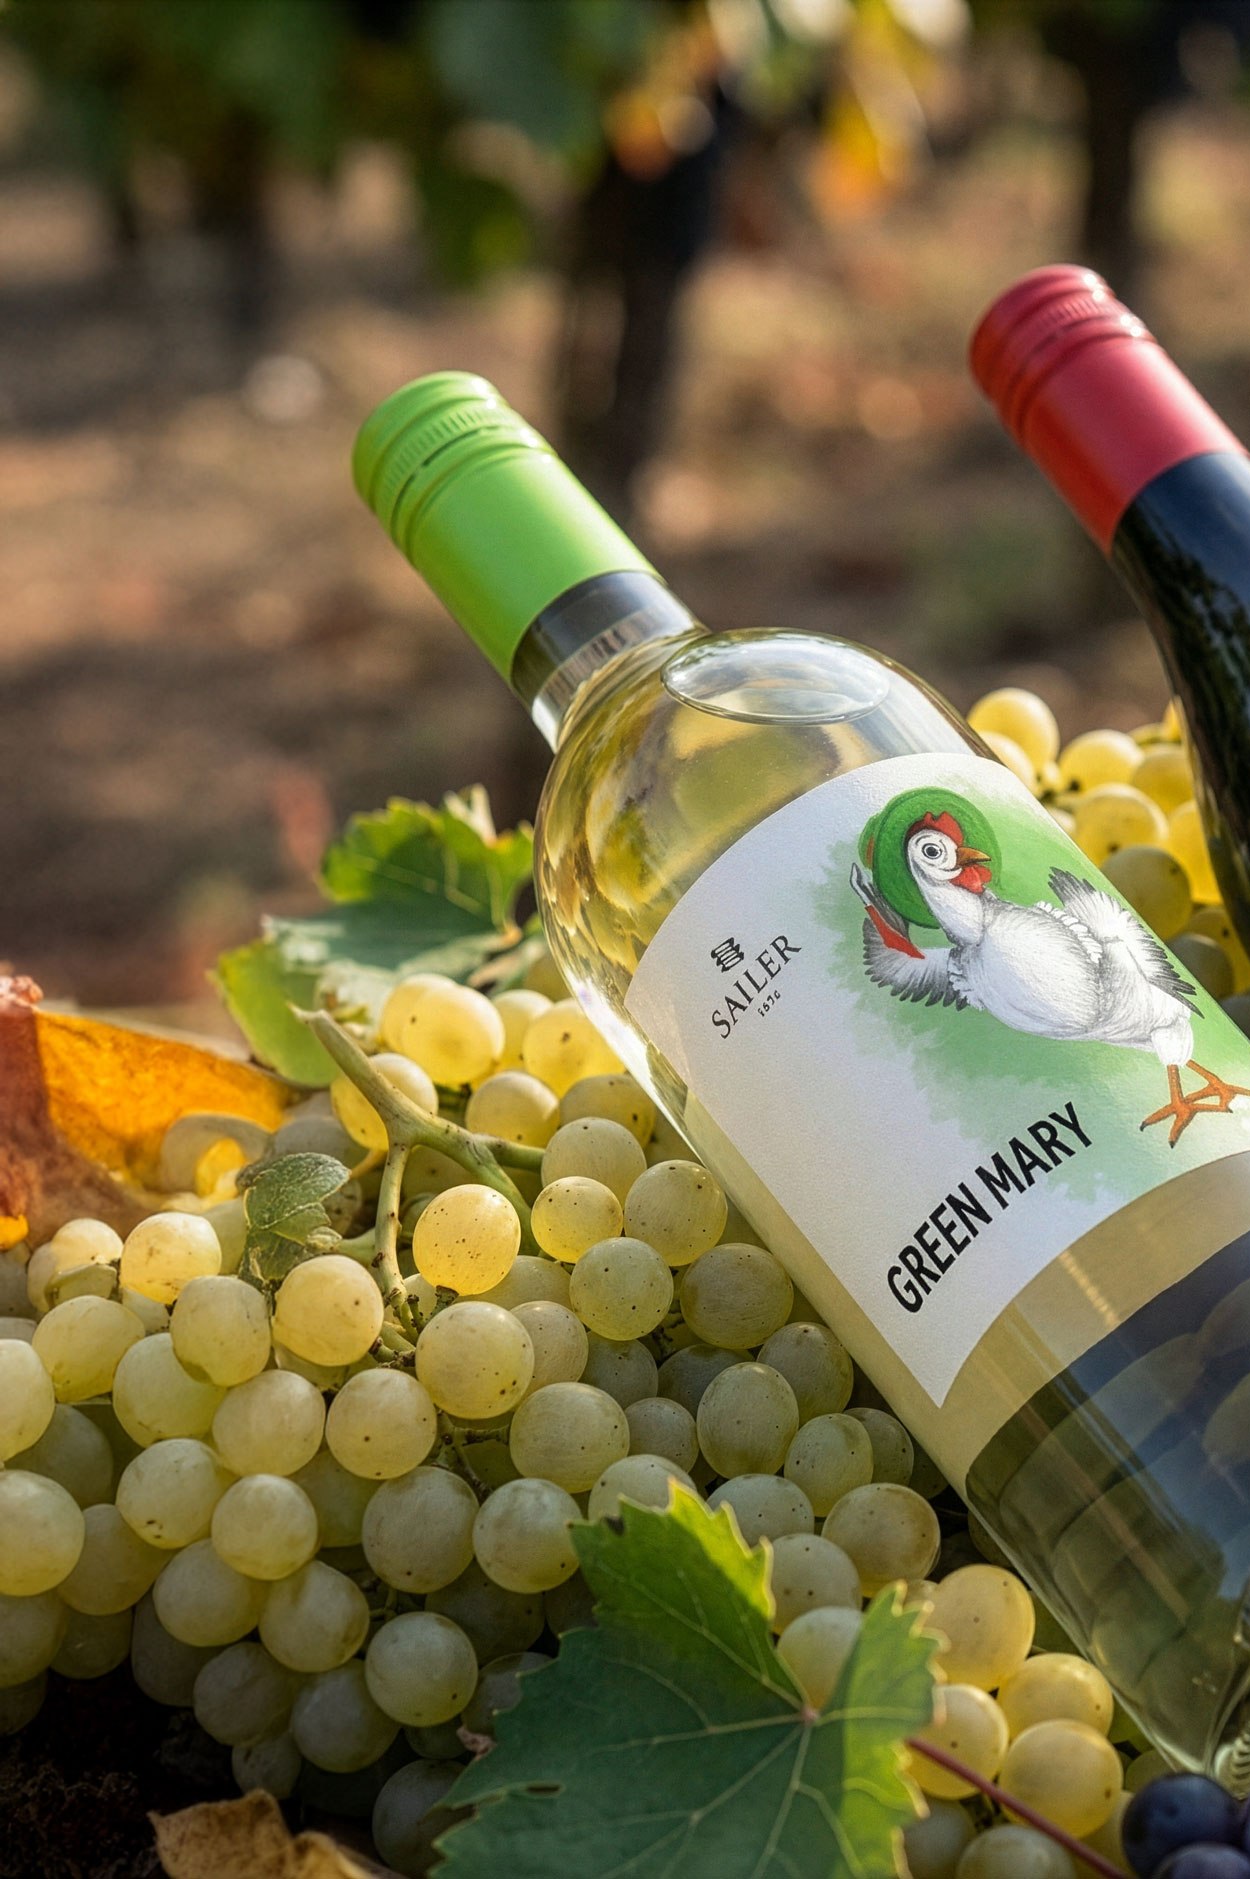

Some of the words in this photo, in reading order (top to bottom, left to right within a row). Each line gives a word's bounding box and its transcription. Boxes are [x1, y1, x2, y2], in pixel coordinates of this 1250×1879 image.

[710, 935, 802, 1040] SAILER
[886, 1182, 993, 1313] GREEN
[974, 1101, 1092, 1210] MARY
